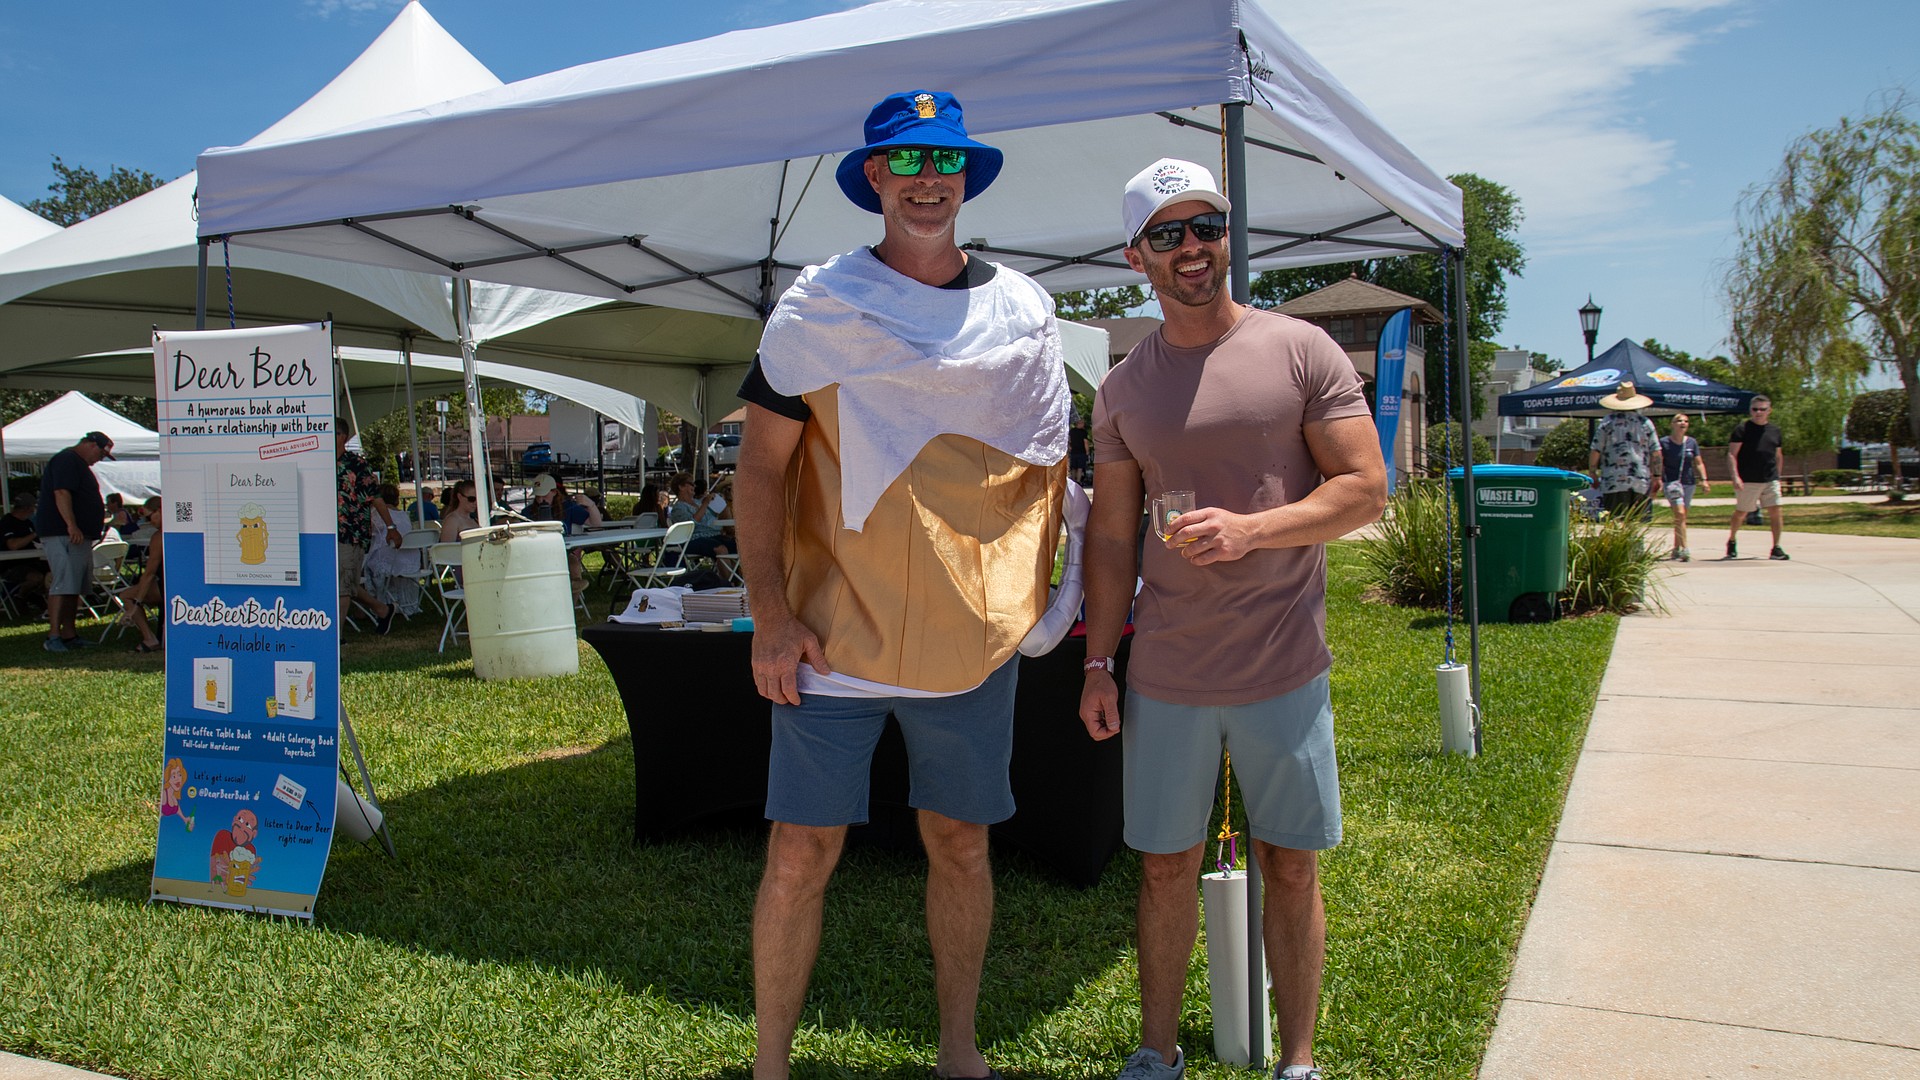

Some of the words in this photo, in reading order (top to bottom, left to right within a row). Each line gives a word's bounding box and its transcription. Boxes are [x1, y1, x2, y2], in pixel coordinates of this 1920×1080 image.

[1152, 165, 1185, 181] CIRCUIT
[1154, 179, 1190, 194] AMERICAS
[173, 350, 245, 392] Dear
[249, 346, 317, 388] Beer
[1523, 398, 1553, 409] TODAY'S
[1554, 396, 1574, 406] BEST
[1575, 395, 1604, 405] COUNT
[1692, 394, 1710, 404] BEST
[187, 403, 194, 416] A
[198, 403, 246, 418] humorous
[250, 399, 272, 416] book
[276, 398, 306, 415] about
[170, 426, 178, 435] a
[182, 418, 213, 435] man's
[217, 419, 277, 438] relationship
[281, 418, 303, 433] with
[306, 415, 329, 432] beer
[262, 445, 289, 455] PARENTAL
[290, 440, 315, 450] ADVISORY
[230, 473, 254, 488] Dear
[254, 473, 277, 488] Beer
[1480, 489, 1513, 501] WASTE
[1515, 489, 1535, 501] PRO
[173, 597, 329, 629] DearBeerBook.com
[217, 633, 271, 653] Avaliable
[275, 640, 286, 653] in
[172, 725, 190, 736] Adult
[192, 726, 213, 737] Coffee
[216, 728, 235, 739] Table
[236, 729, 252, 740] Book
[267, 732, 285, 743] Adult
[287, 733, 315, 748] Coloring
[318, 735, 334, 746] Book
[182, 740, 208, 749] Full-Color
[209, 741, 240, 752] Hardcover
[284, 747, 316, 759] Paperback
[194, 770, 209, 781] Let's
[211, 773, 222, 785] get
[198, 788, 250, 801] @DearBeerBook
[264, 818, 284, 829] listen
[286, 820, 293, 830] to
[295, 820, 313, 832] Dear
[315, 822, 331, 833] Beer
[278, 833, 296, 848] right
[298, 836, 314, 845] now!
